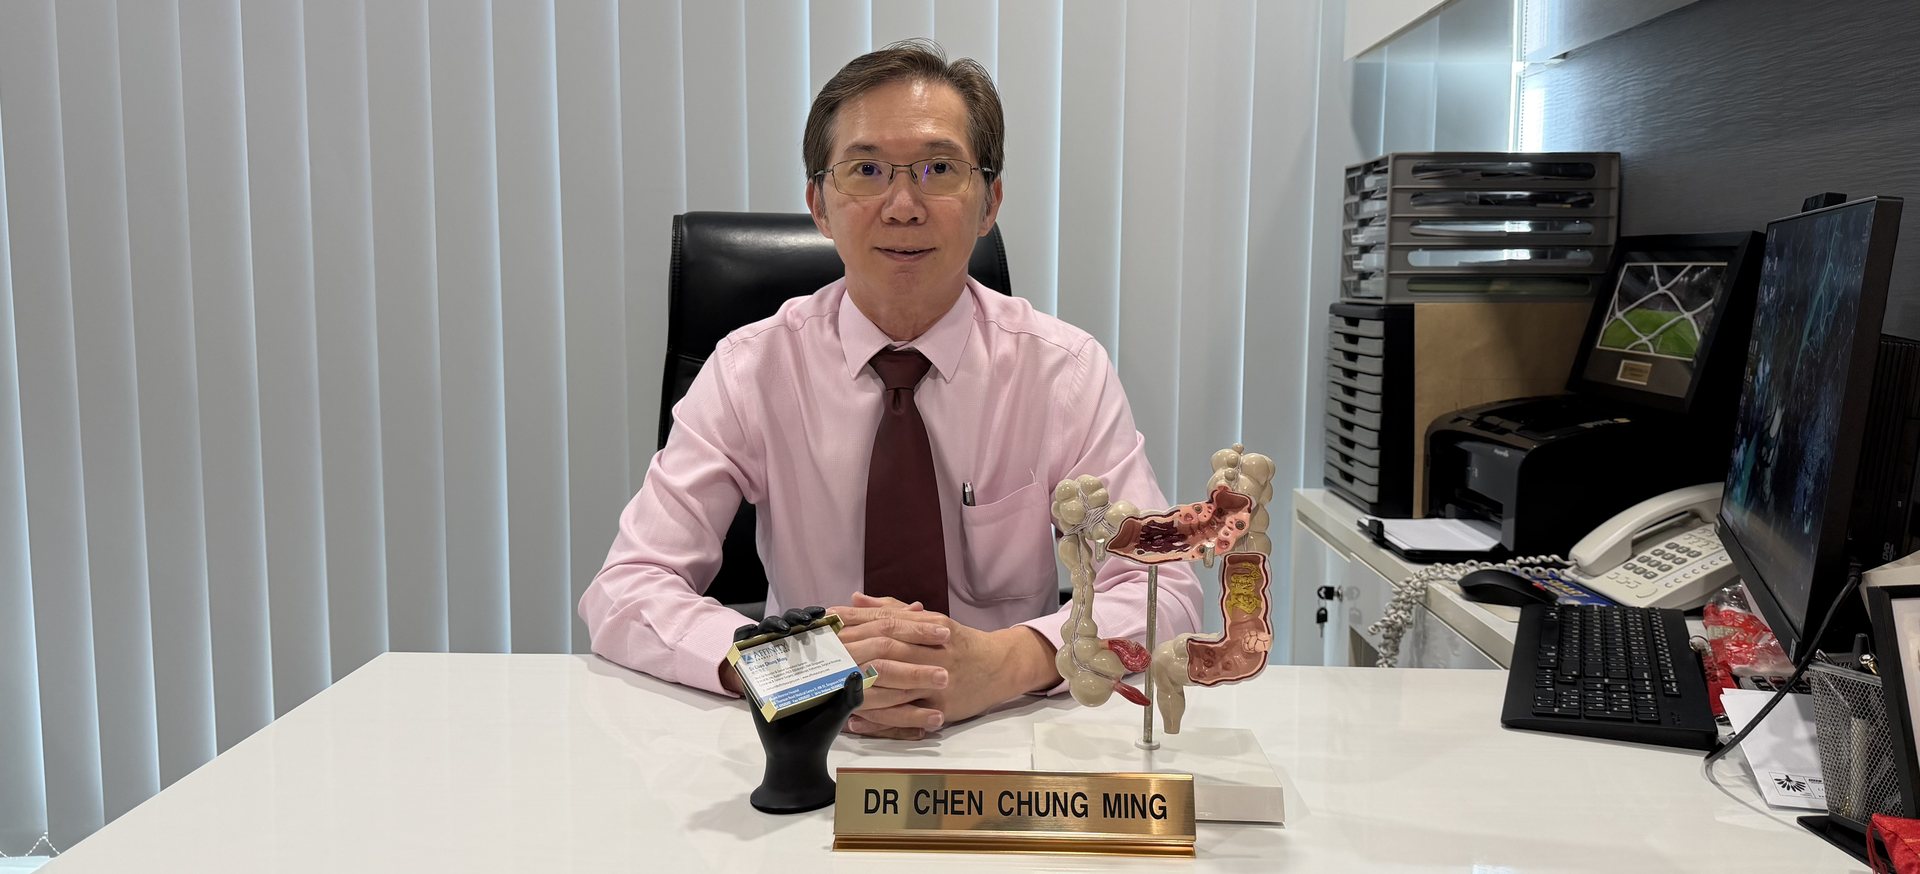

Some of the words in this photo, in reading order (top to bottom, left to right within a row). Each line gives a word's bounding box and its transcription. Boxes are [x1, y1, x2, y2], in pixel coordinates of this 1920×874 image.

[864, 788, 899, 815] DR
[913, 789, 984, 816] CHEN
[997, 790, 1089, 818] CHUNG
[1102, 792, 1168, 820] MING
